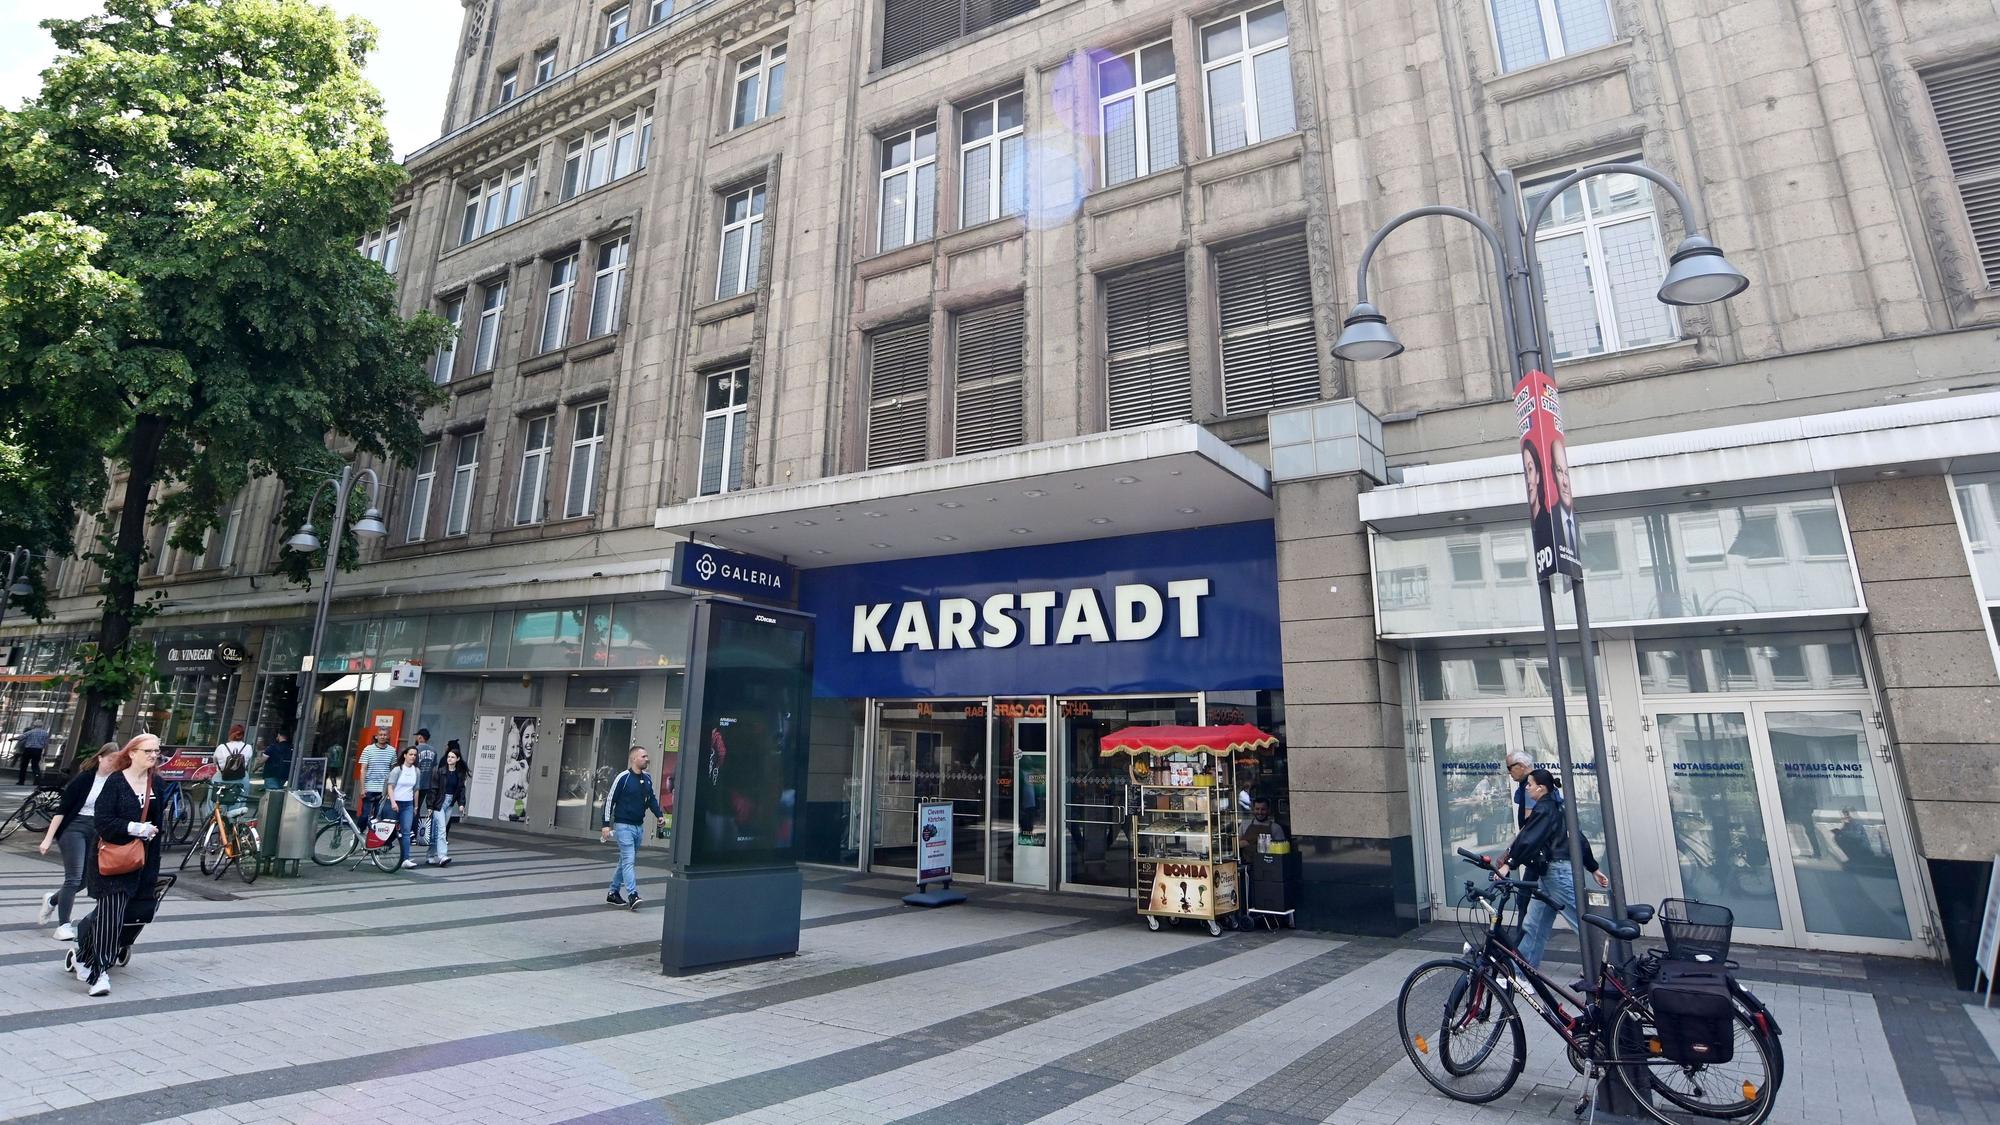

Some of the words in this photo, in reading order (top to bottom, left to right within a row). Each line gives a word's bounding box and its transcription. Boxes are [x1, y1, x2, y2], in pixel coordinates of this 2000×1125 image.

[1536, 546, 1553, 573] SPD
[721, 564, 781, 588] GALERIA
[852, 579, 1209, 653] KARSTADT
[182, 648, 213, 661] VINEGAR
[1673, 763, 1744, 771] NOTAUSGANG!
[1784, 763, 1863, 771] NOTAUSGANG!
[1163, 863, 1208, 879] BOMBA
